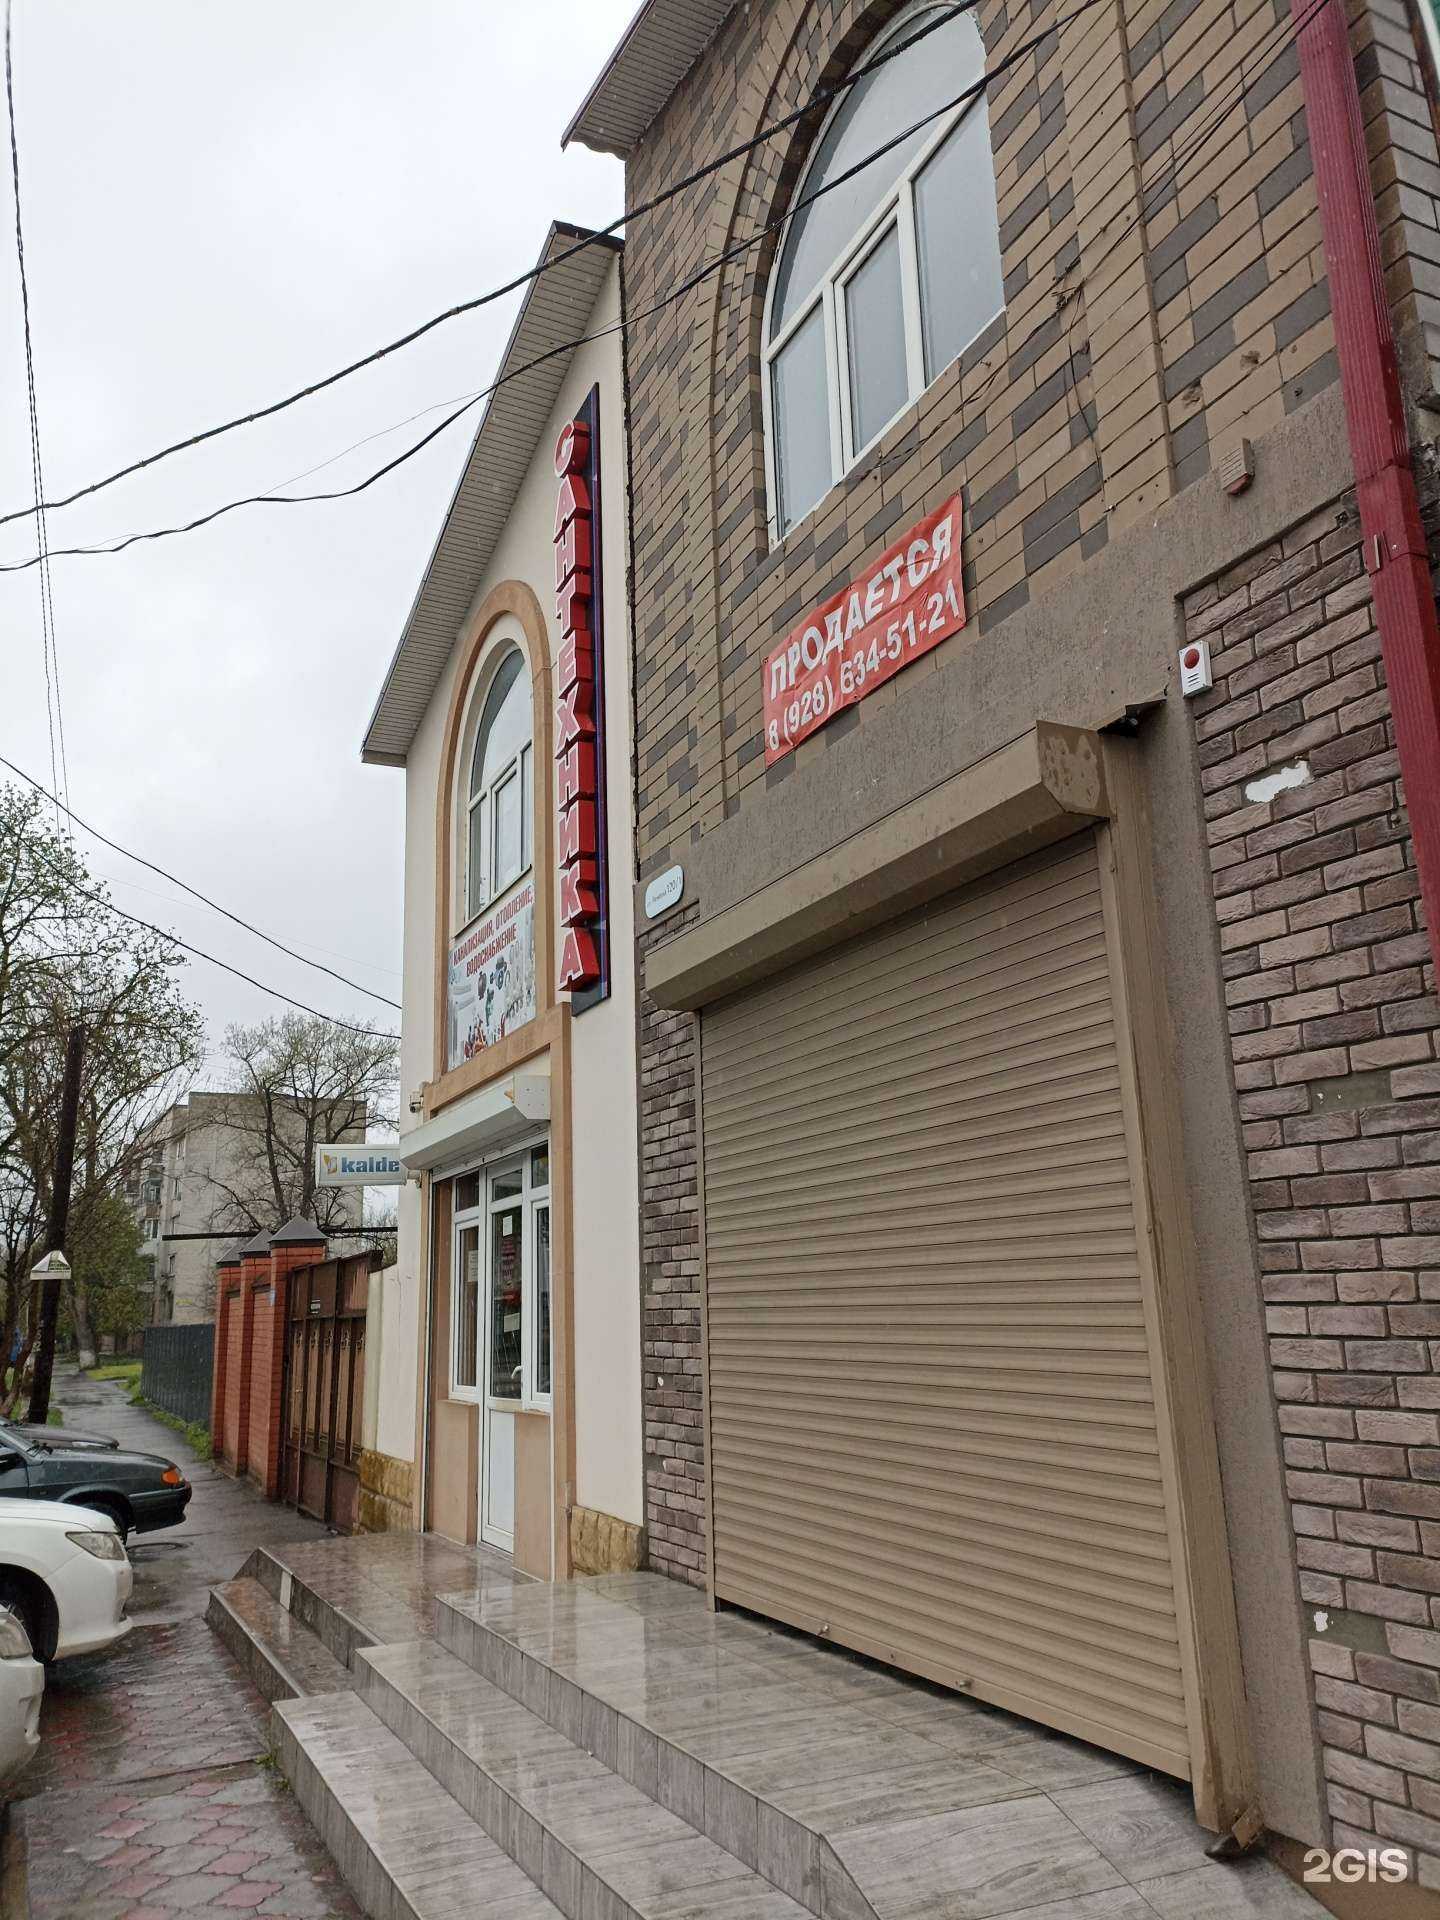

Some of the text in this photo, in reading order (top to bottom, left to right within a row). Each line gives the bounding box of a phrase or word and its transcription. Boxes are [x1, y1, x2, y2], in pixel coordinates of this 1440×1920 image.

[767, 578, 960, 751] 8 (928) 634-51-21
[770, 514, 953, 701] ПРОДАЕТСЯ
[553, 418, 591, 989] САНТЕХНИКА
[466, 922, 517, 978] ВОДОСНАБЖЕНИЕ
[341, 1156, 400, 1173] kalde
